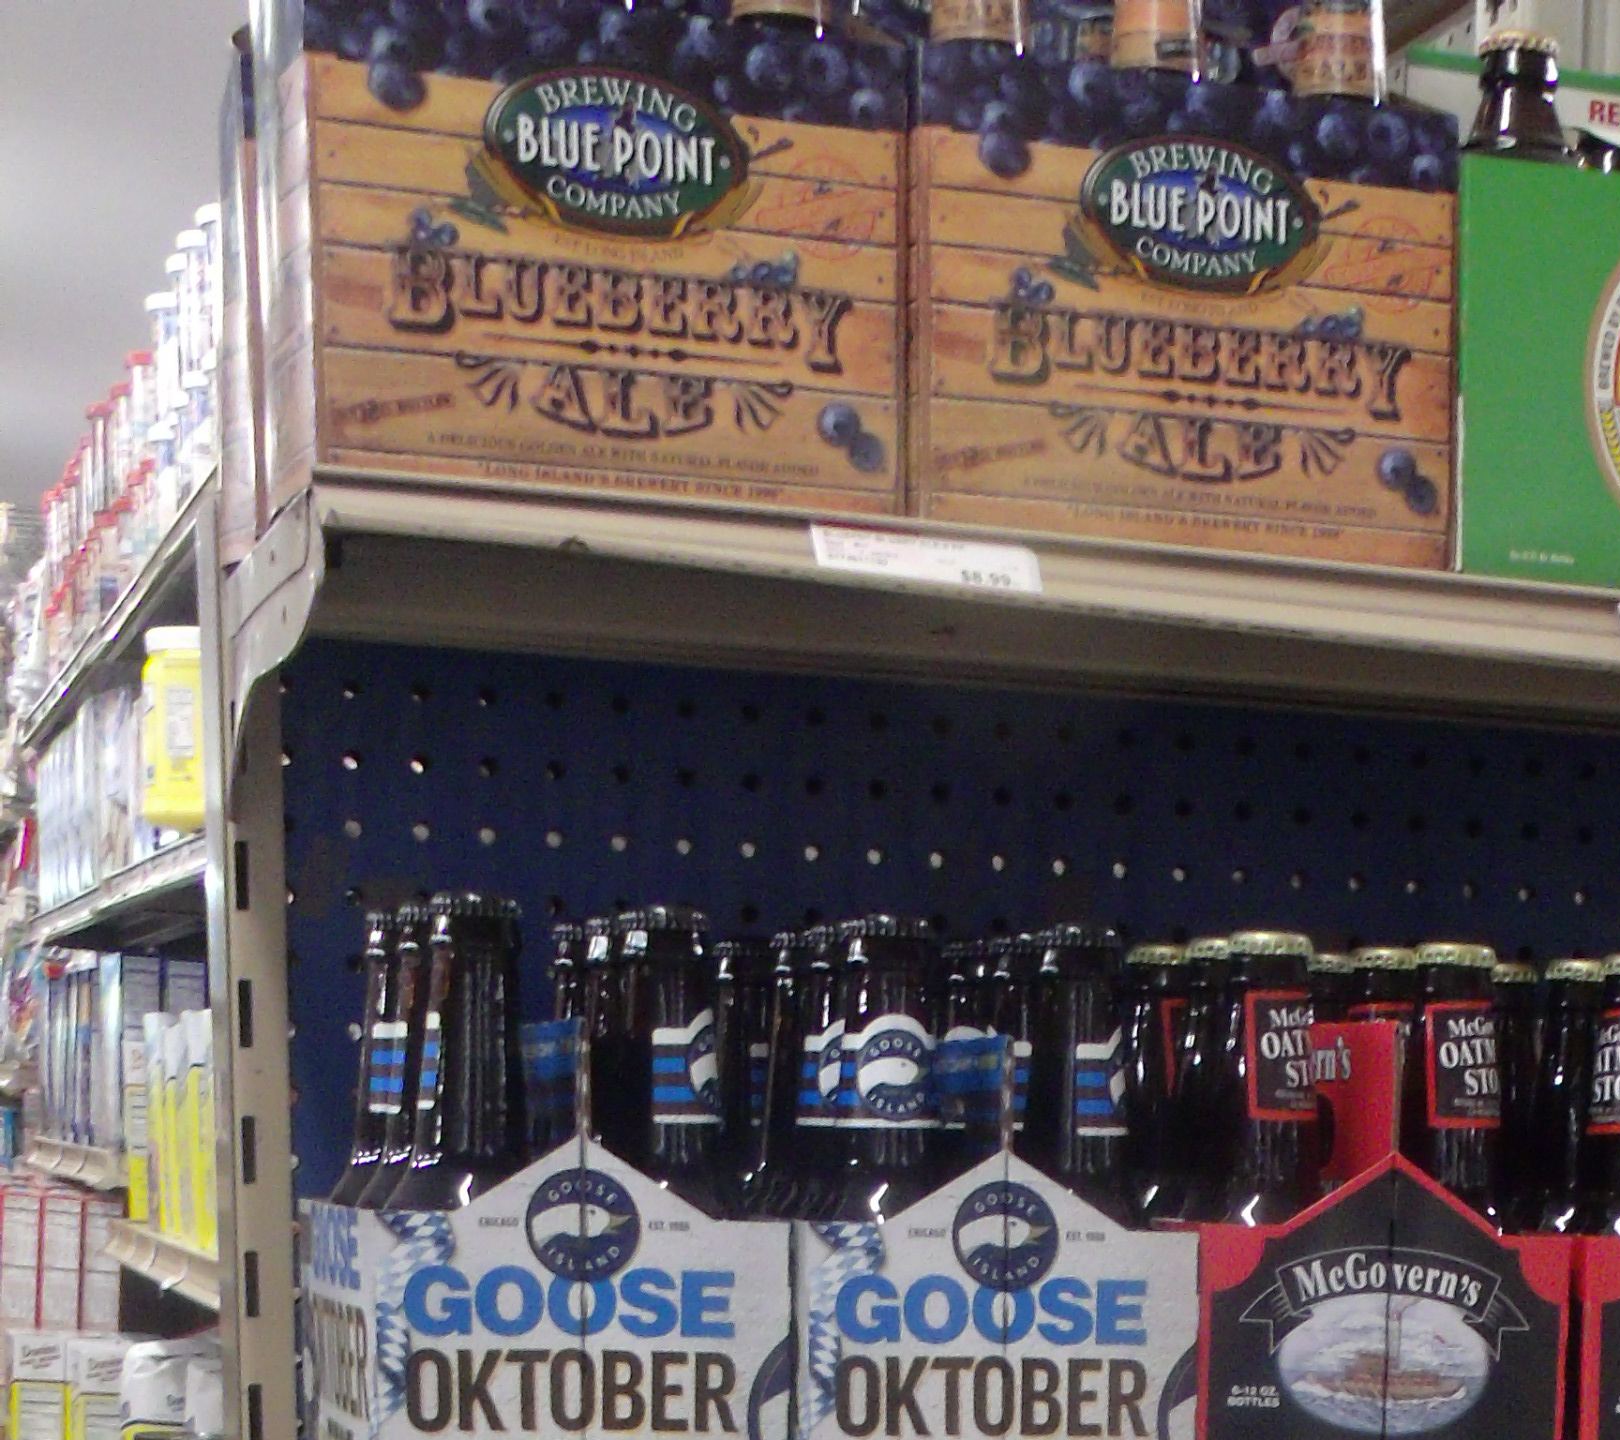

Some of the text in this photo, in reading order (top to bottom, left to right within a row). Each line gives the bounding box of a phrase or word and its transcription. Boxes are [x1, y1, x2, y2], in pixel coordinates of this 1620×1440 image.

[536, 74, 698, 133] BREWING
[516, 114, 716, 185] BLUE POINT
[1129, 145, 1275, 196] BREWING
[547, 175, 682, 219] COMPANY
[1109, 179, 1290, 245] BLUE POINT
[1136, 236, 1257, 277] COMPANY
[389, 245, 853, 375] BLUEBERRY
[988, 302, 1411, 422] BLUEBERRY
[532, 362, 716, 440] ALE
[1118, 411, 1282, 482] ALE
[547, 1179, 619, 1203] GOOSE
[972, 1193, 1038, 1214] GOOSE
[547, 1246, 623, 1273] ISLAND
[404, 1265, 736, 1338] GOOSE
[835, 1274, 1147, 1346] GOOSE
[406, 1349, 738, 1434] OKTOBER
[835, 1355, 1148, 1439] OKTOBER
